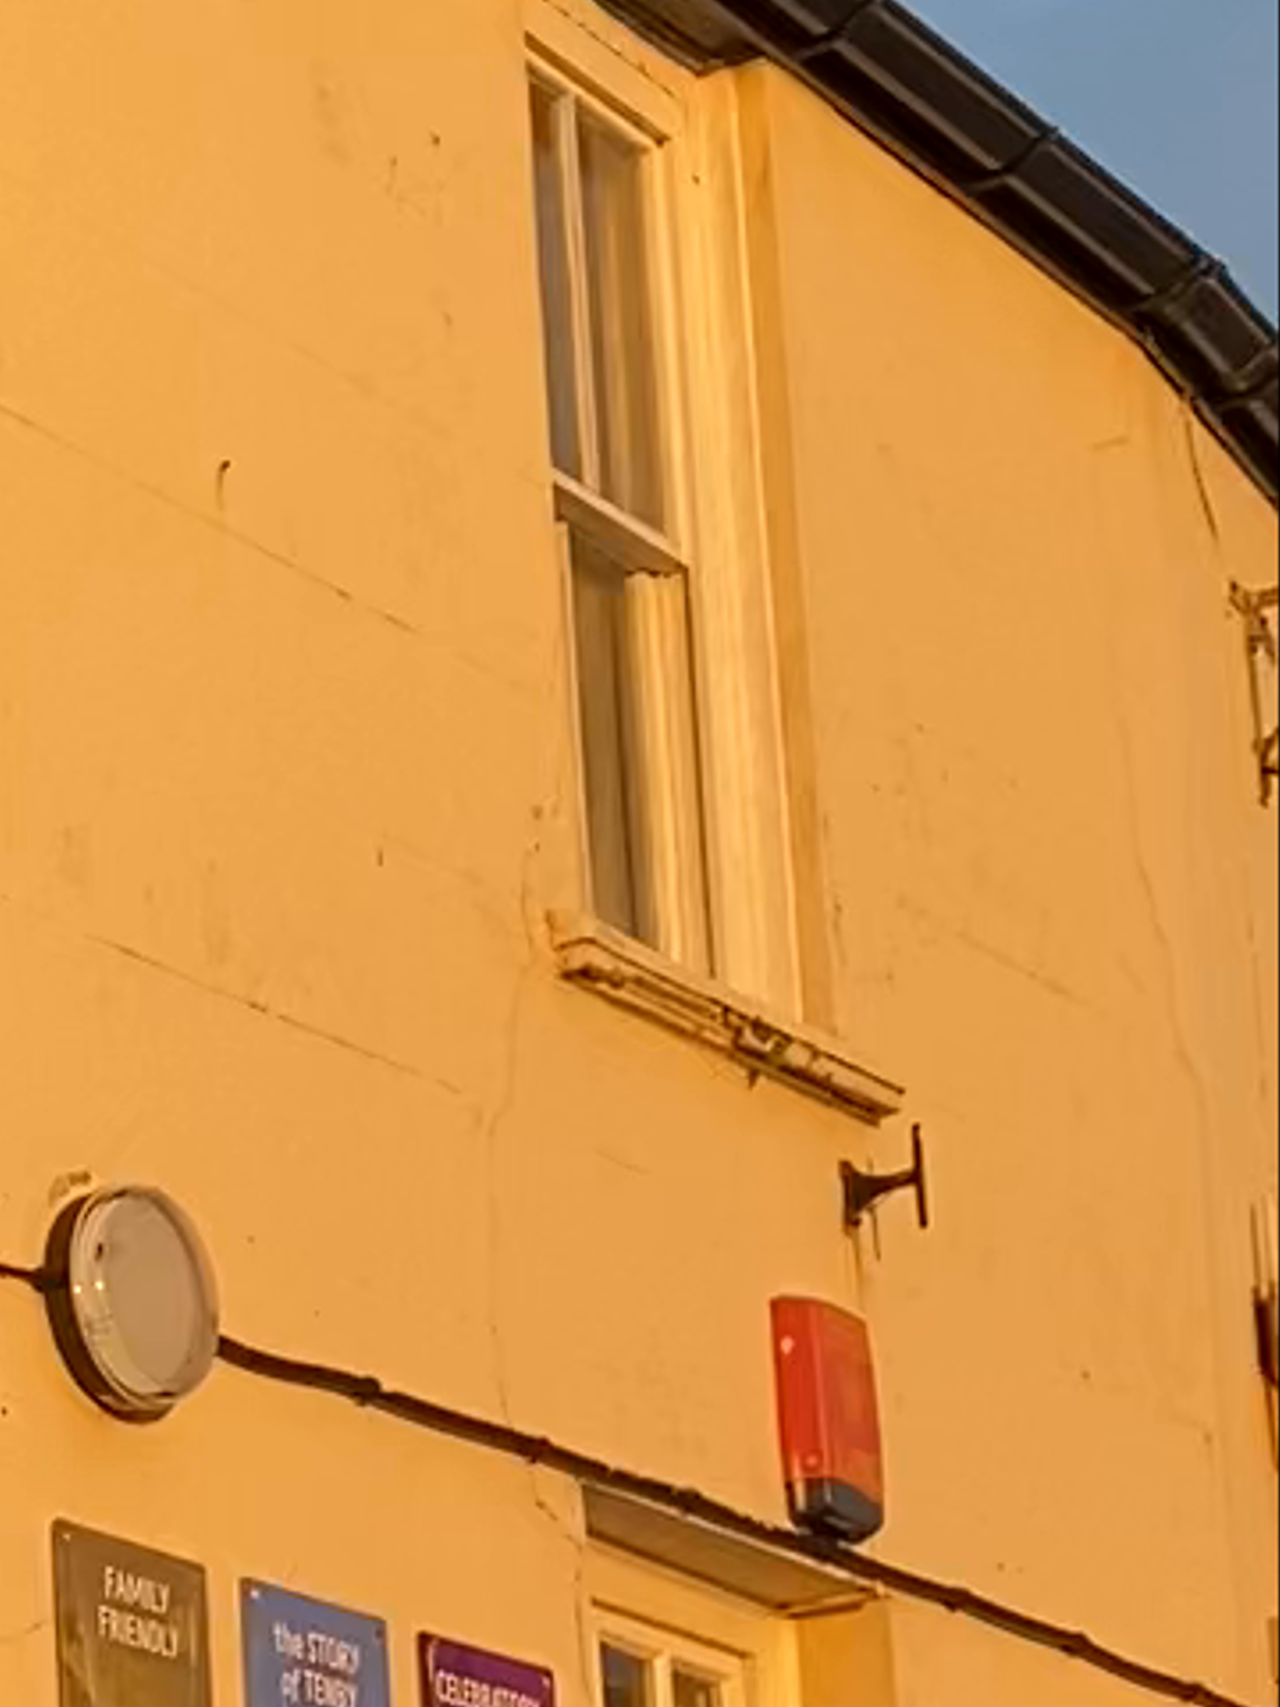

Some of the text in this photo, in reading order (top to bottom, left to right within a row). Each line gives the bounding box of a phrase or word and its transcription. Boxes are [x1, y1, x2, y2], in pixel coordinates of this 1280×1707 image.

[104, 1565, 170, 1614] FAMILY
[98, 1605, 178, 1658] FRIENDLY
[273, 1622, 359, 1674] the STORY
[282, 1669, 300, 1704] of
